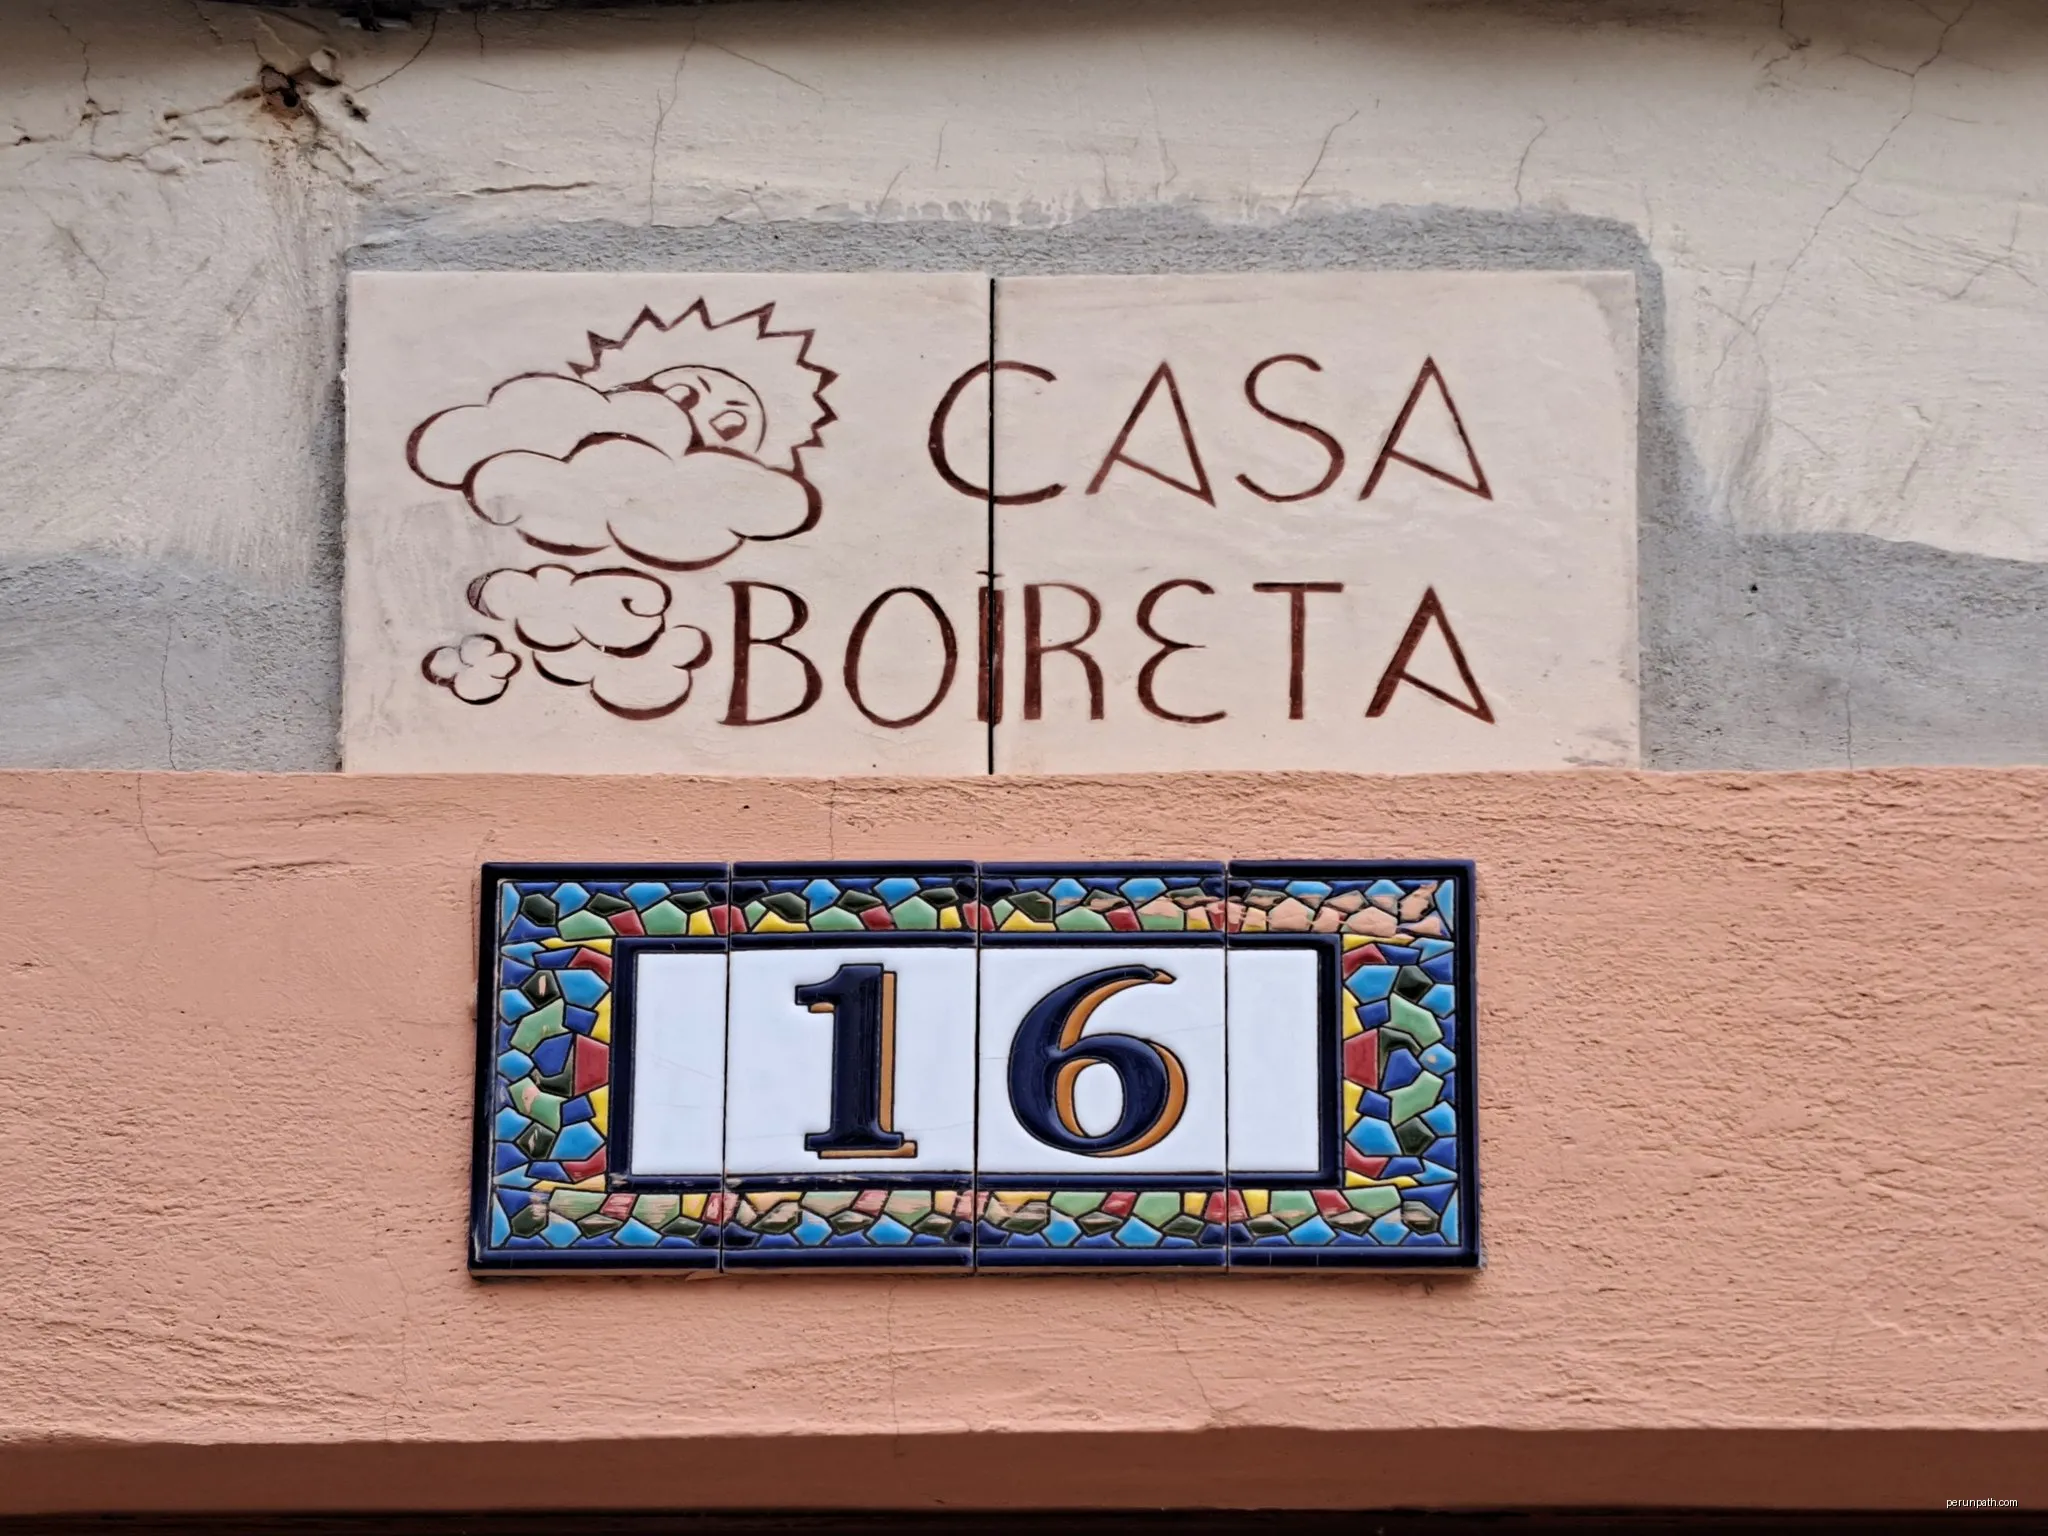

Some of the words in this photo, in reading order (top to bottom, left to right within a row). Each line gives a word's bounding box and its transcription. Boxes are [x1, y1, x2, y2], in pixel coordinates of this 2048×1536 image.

[928, 354, 1493, 507] CASA
[717, 576, 1496, 729] BOIRETA
[794, 963, 1190, 1158] 16
